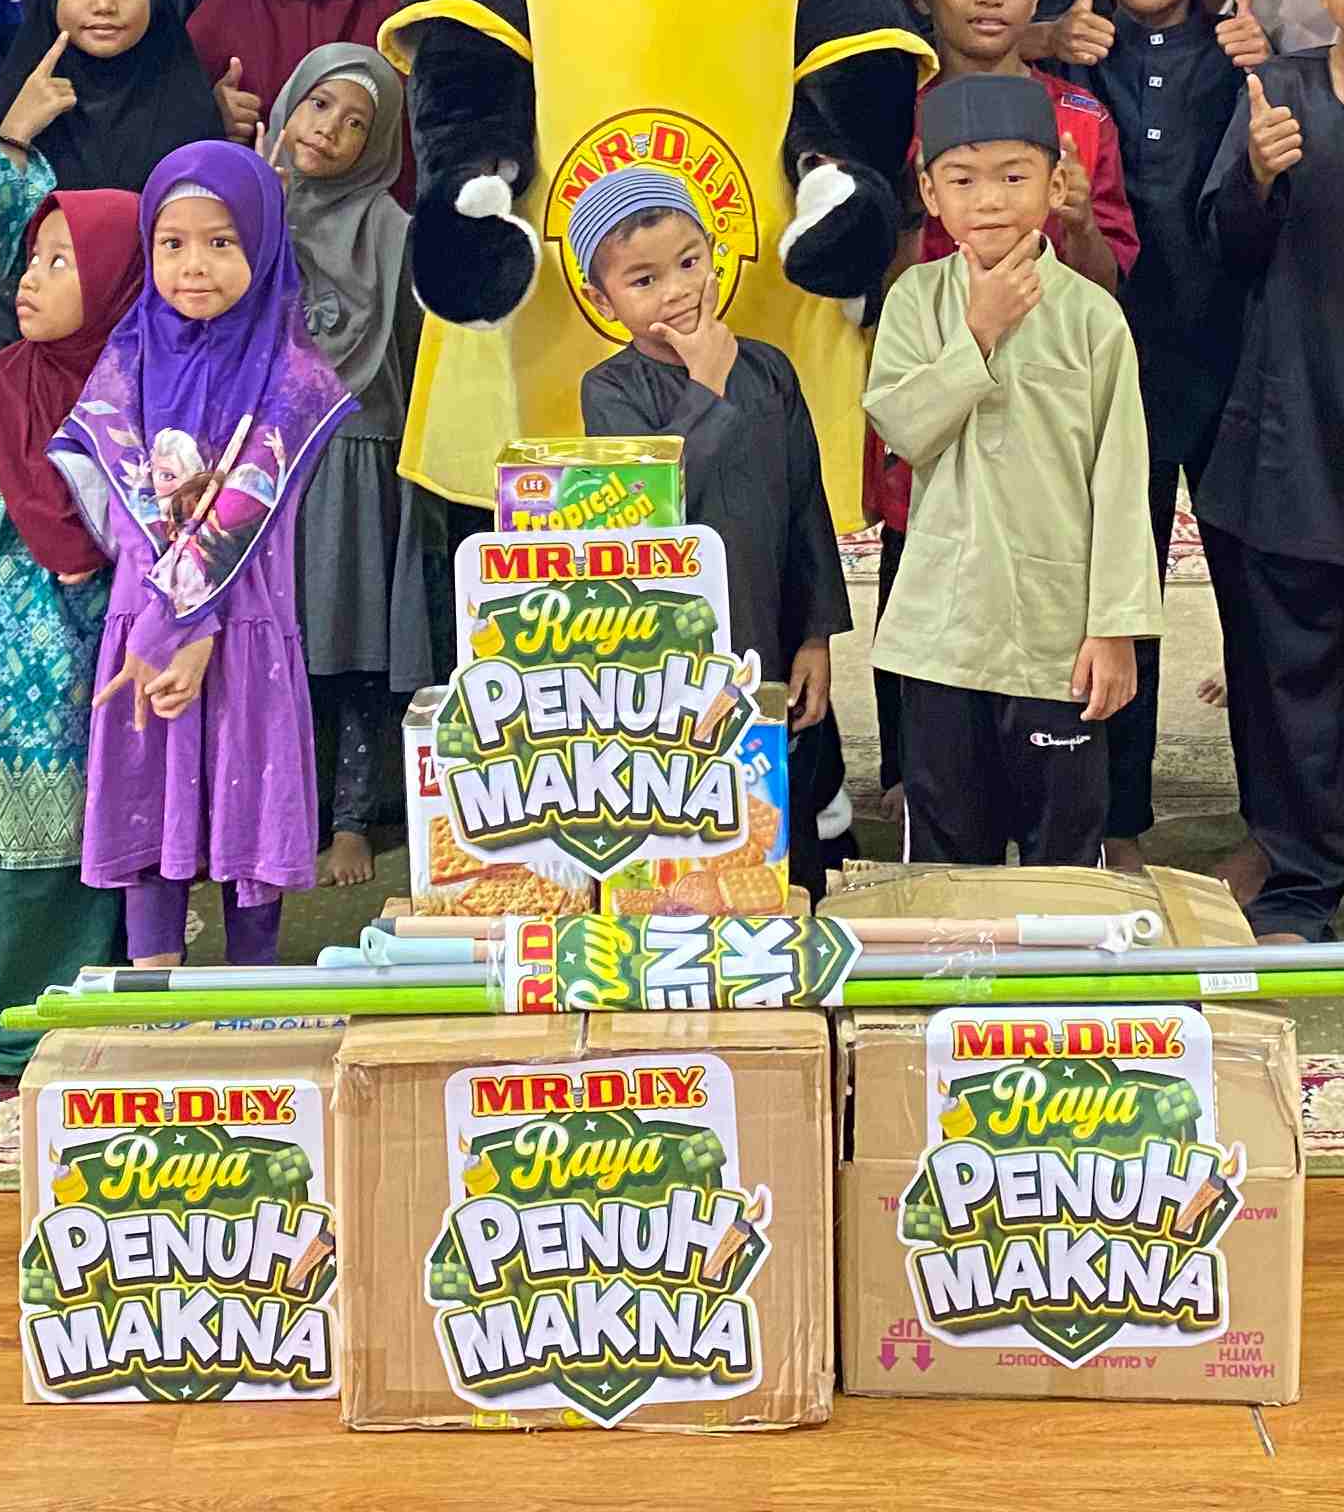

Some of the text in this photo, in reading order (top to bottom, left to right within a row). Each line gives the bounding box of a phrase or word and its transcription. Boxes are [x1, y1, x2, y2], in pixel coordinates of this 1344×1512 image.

[512, 472, 629, 532] Tropical
[522, 480, 544, 491] LEE
[517, 590, 659, 655] Raya
[460, 654, 728, 746] PENUH
[450, 742, 739, 832] MAKNA
[988, 1066, 1140, 1137] Raya
[98, 1134, 251, 1201] Raya
[510, 1121, 664, 1191] Raya
[930, 1139, 1218, 1232] PENUH
[43, 1201, 324, 1292] PENUH
[455, 1188, 740, 1286] PENUH
[918, 1229, 1218, 1316] MAKNA
[31, 1288, 327, 1379] MAKNA
[446, 1278, 748, 1376] MAKNA
[888, 1319, 923, 1337] UP
[1145, 1355, 1158, 1368] A
[1217, 1331, 1264, 1345] CARE
[1219, 1348, 1262, 1361] WITH
[1205, 1363, 1275, 1378] HANDLE
